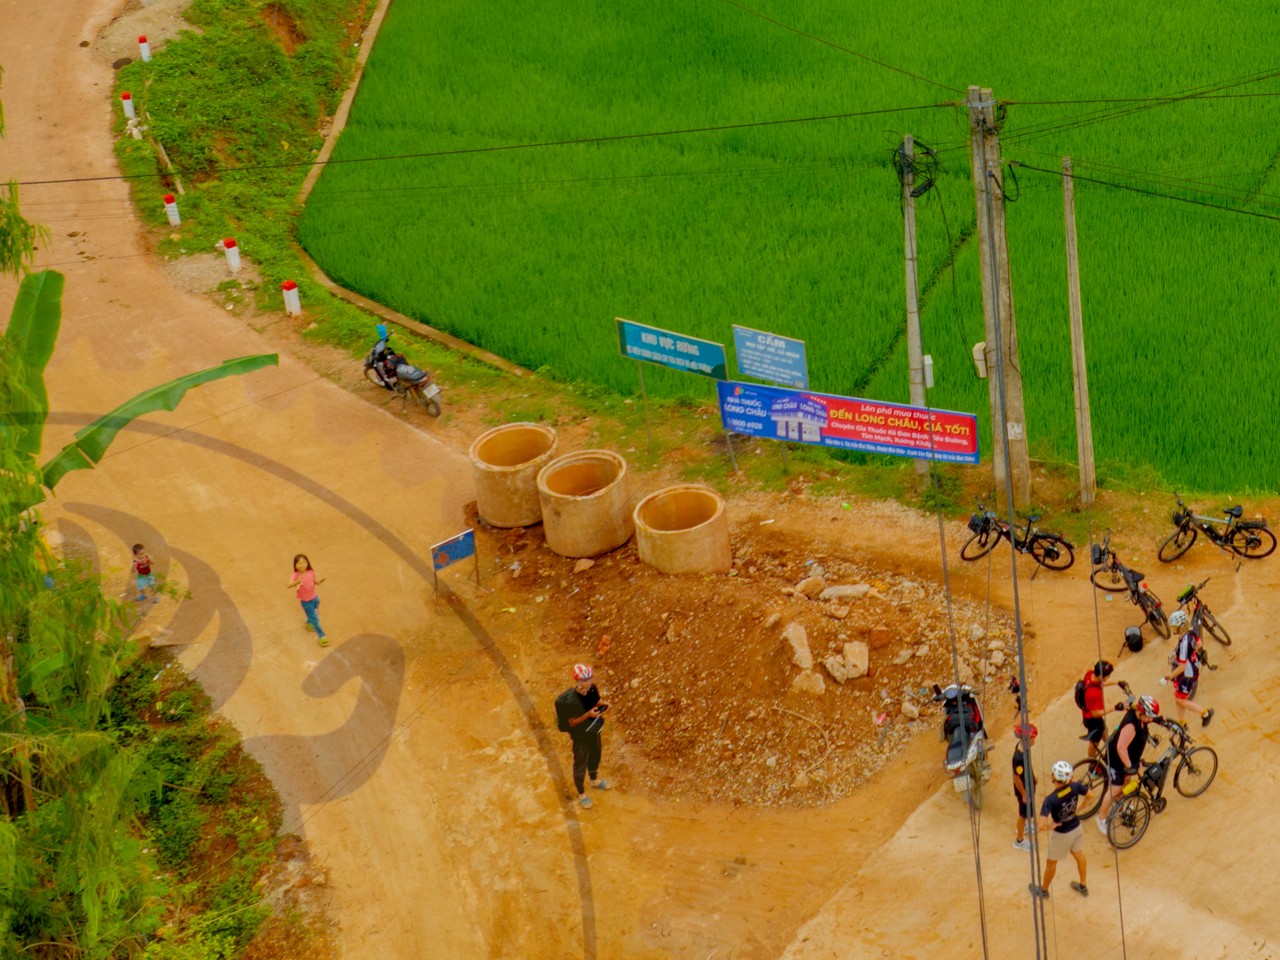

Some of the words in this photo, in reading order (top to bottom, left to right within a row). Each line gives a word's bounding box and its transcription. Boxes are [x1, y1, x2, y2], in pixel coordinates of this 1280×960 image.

[641, 332, 657, 345] KHU
[727, 396, 740, 404] NHÀ
[741, 397, 762, 407] THUỐC
[724, 403, 745, 414] LONG
[746, 406, 767, 417] CHÂU
[877, 406, 892, 415] phố
[893, 410, 912, 418] mua
[829, 408, 853, 421] ĐẾN
[855, 413, 885, 425] LONG
[887, 416, 921, 431] CHÂU,
[944, 424, 970, 436] TỐT!
[831, 422, 855, 430] Chuyên
[868, 426, 886, 434] Thuốc
[912, 432, 929, 440] Bệnh
[874, 434, 893, 442] Mạch,
